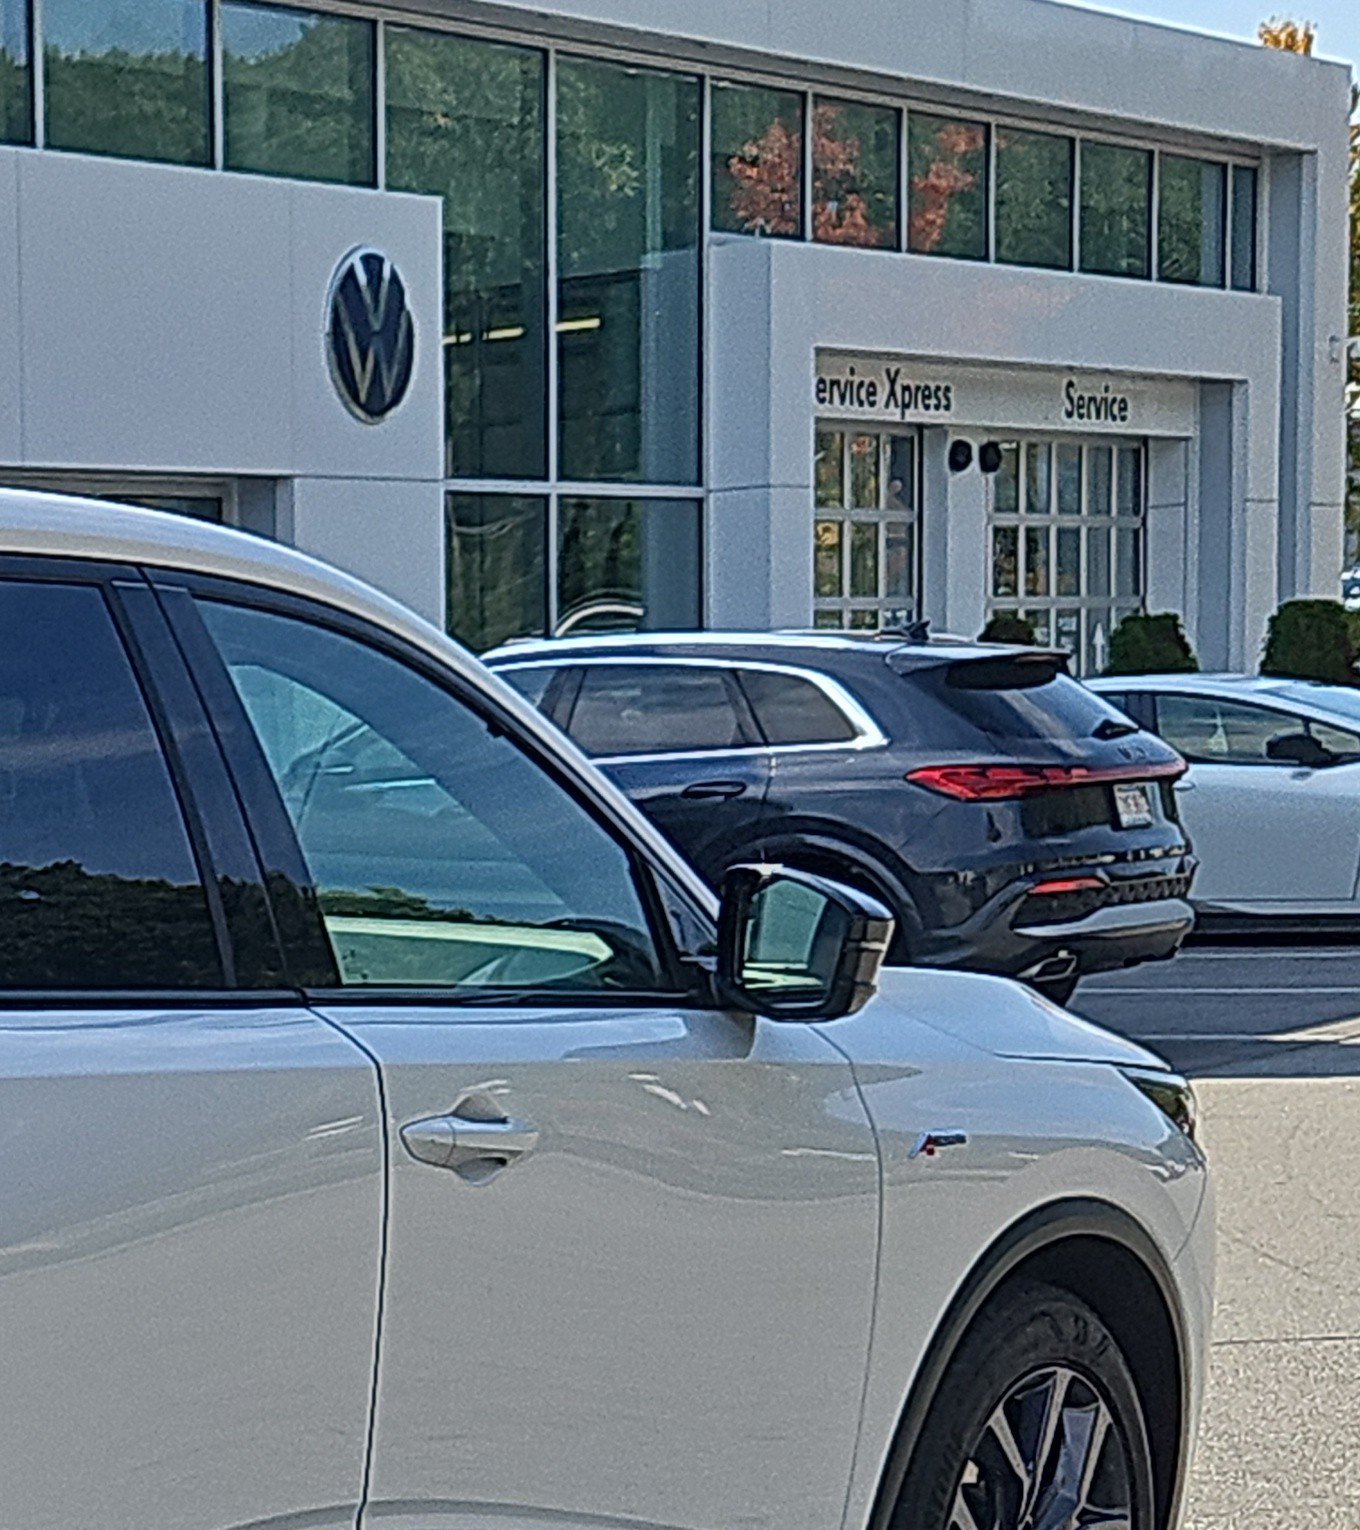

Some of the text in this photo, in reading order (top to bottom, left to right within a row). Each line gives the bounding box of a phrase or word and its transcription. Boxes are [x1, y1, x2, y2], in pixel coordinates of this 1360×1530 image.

[815, 366, 952, 420] ervice Xpress
[1064, 379, 1128, 422] Service
